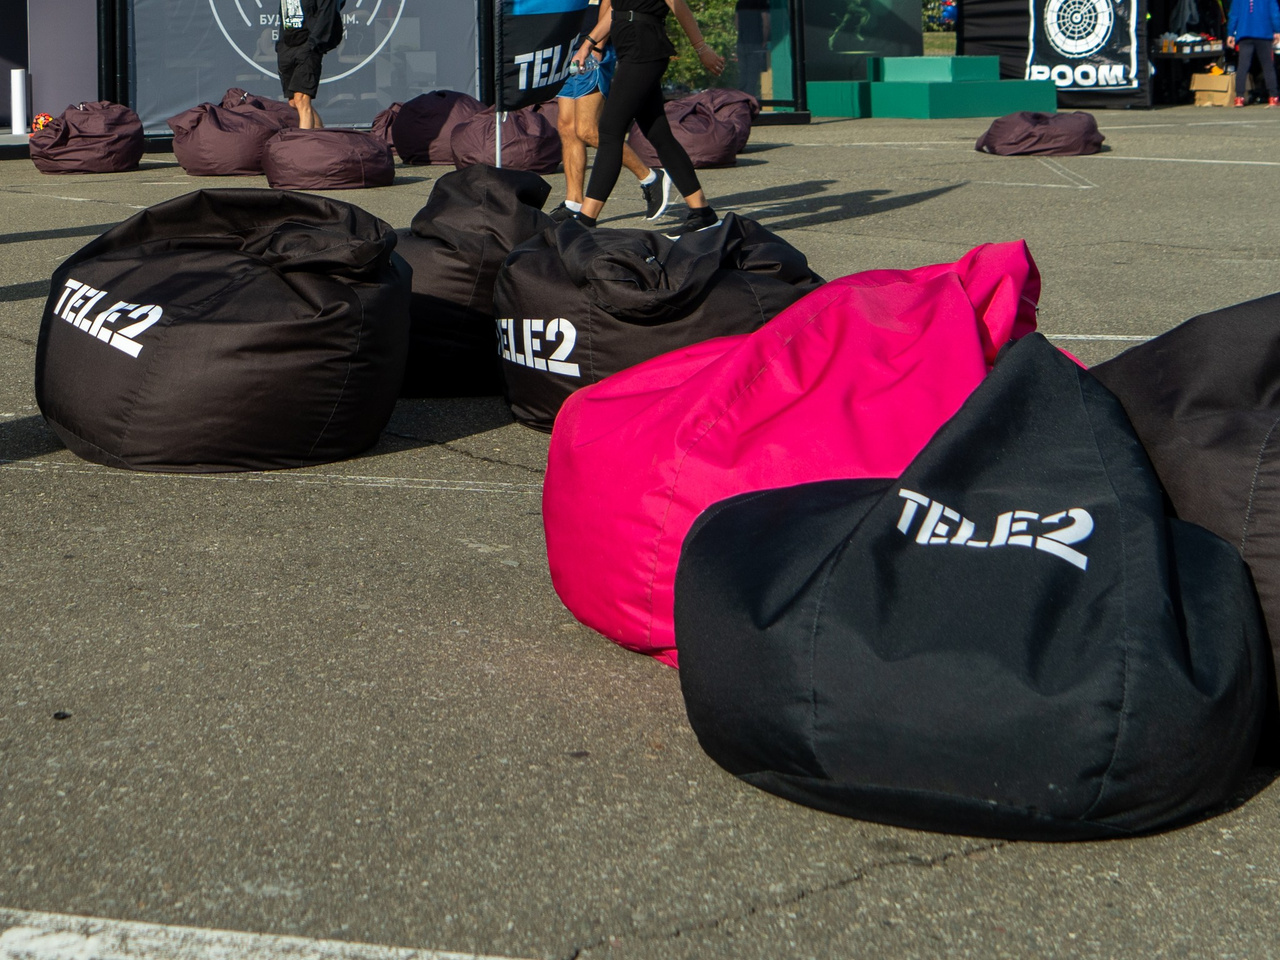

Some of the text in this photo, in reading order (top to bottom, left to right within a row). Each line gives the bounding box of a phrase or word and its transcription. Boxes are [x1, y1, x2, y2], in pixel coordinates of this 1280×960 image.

[53, 278, 163, 358] TELE2
[495, 318, 580, 377] ELE2
[898, 489, 1095, 570] TELE2
